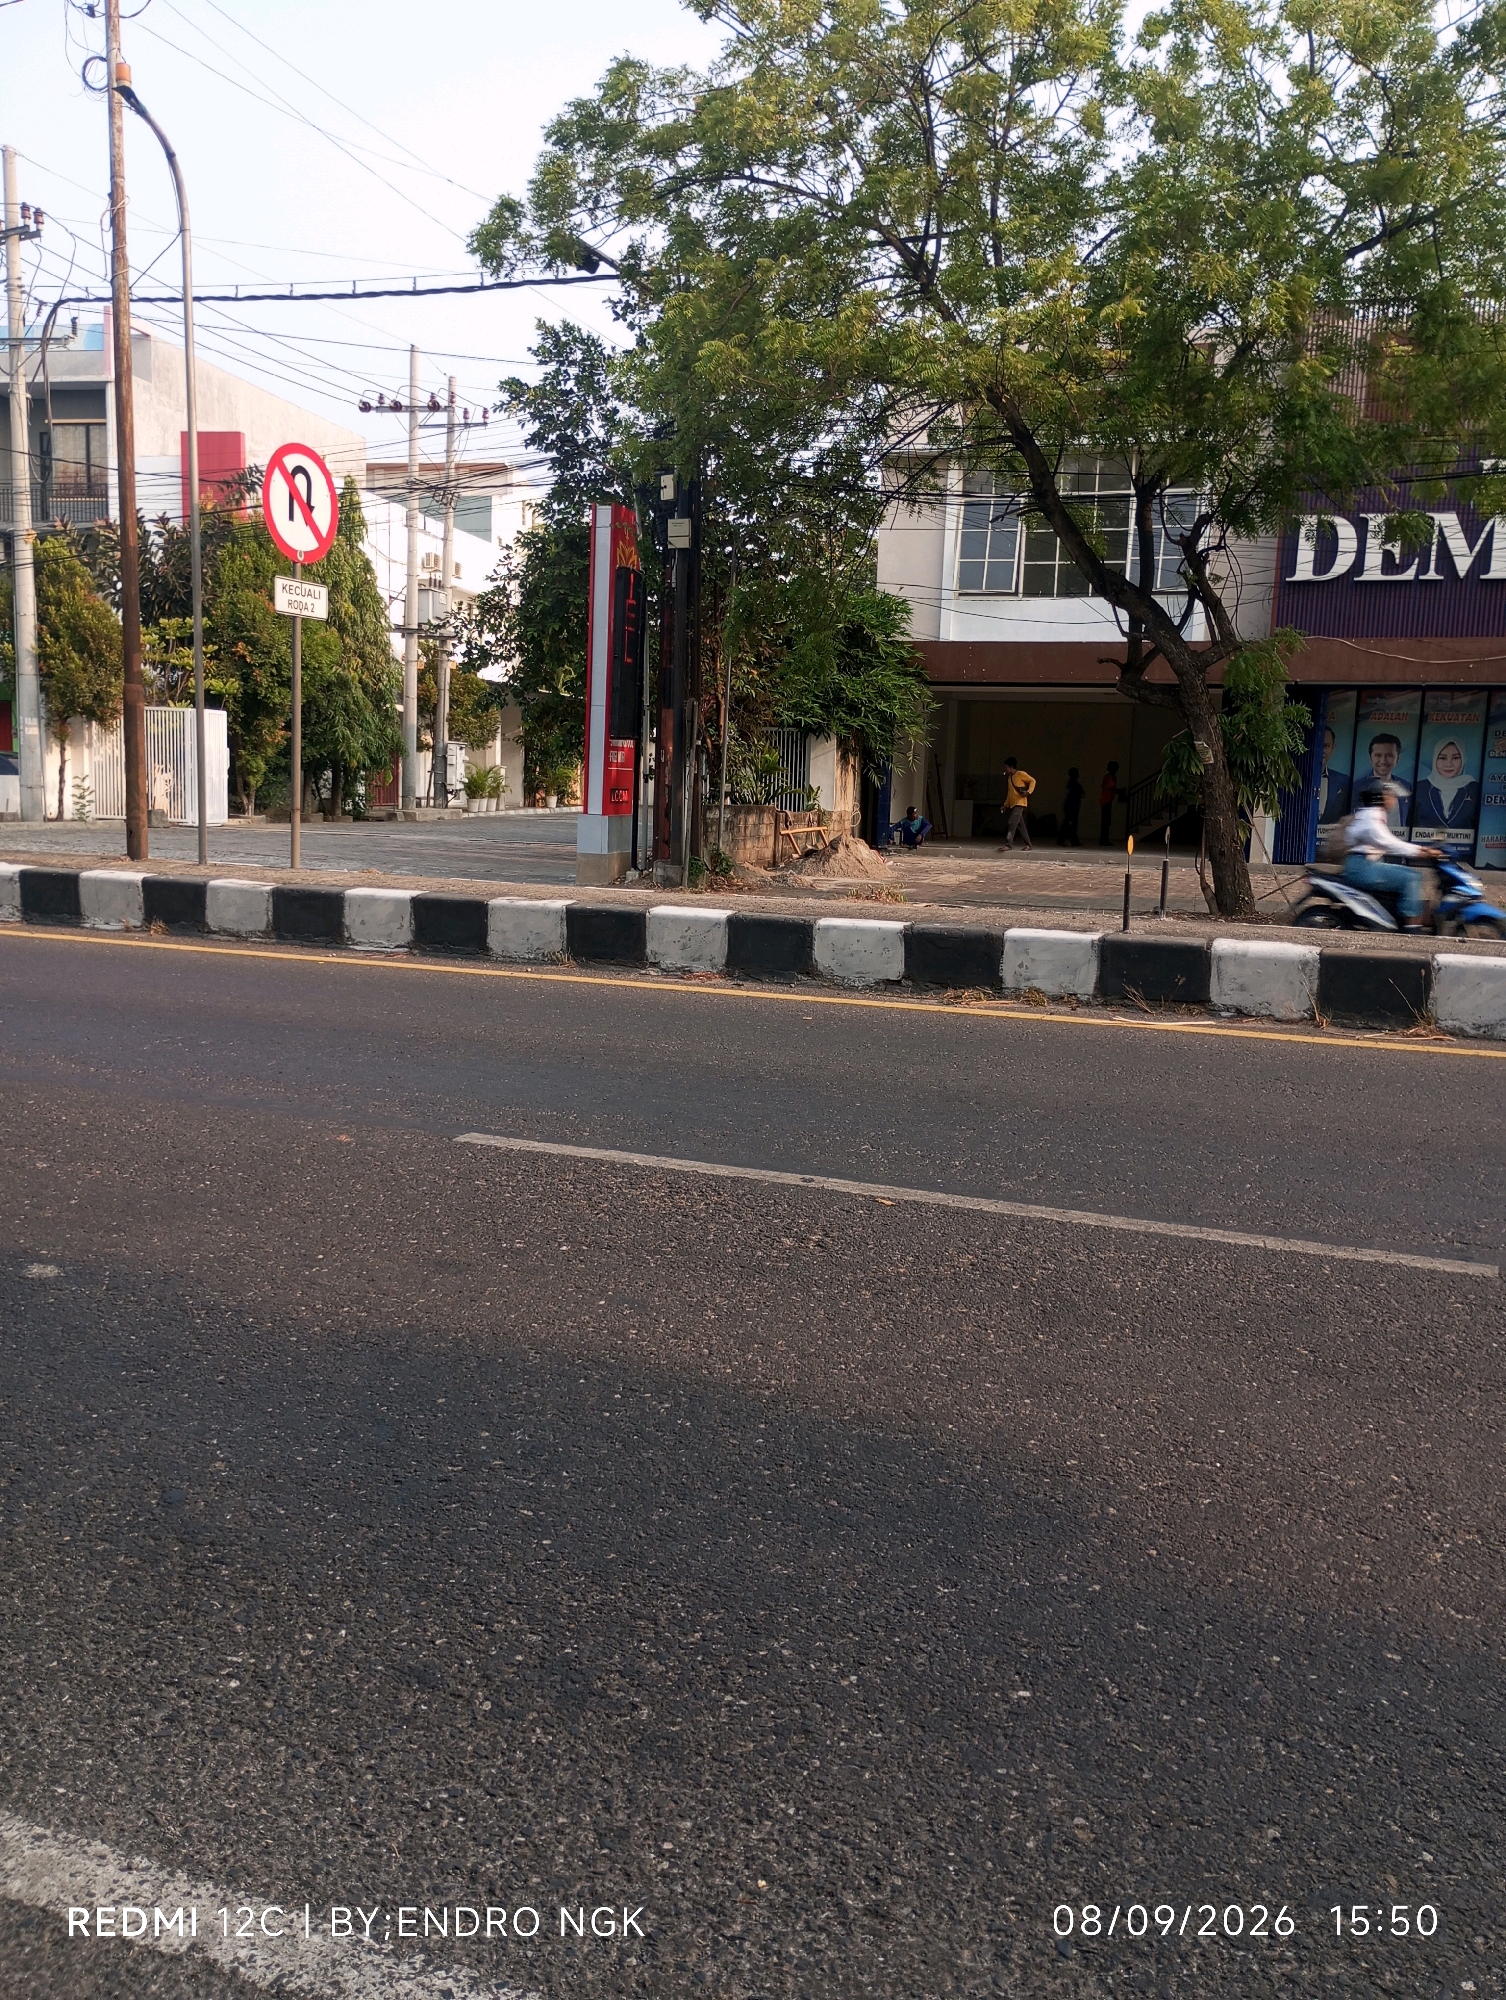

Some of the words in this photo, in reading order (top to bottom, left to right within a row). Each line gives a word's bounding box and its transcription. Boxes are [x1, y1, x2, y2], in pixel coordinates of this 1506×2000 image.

[1286, 511, 1506, 582] DEM
[281, 583, 321, 600] KECUALI
[287, 599, 309, 612] RODA
[310, 603, 315, 613] 2
[1369, 711, 1409, 721] ADALAH
[1428, 712, 1481, 722] KEKUATAN
